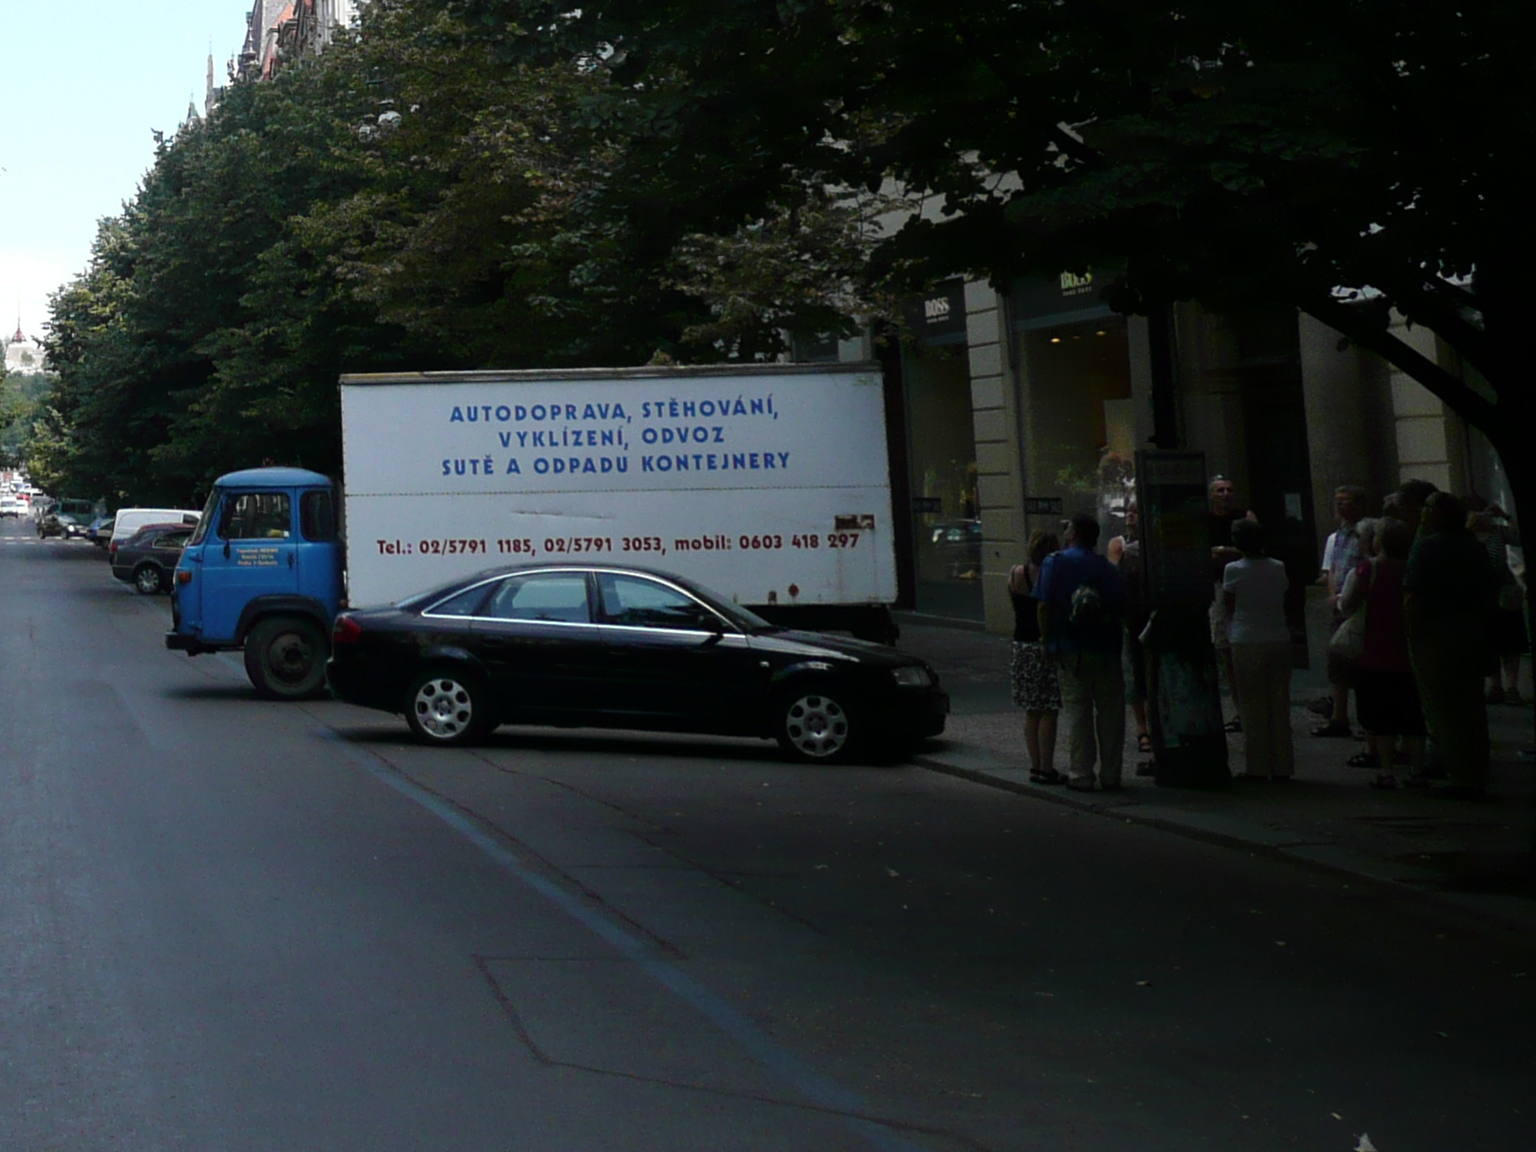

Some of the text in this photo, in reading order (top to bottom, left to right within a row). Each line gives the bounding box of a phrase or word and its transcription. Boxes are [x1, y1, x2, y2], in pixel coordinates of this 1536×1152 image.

[449, 395, 778, 424] AUTODOPRAVA, STĚHOVÁNÍ,
[498, 426, 725, 451] VYKLÍZENÍ, ODVOZ
[442, 452, 790, 476] SUTĚ A ODPADU KONTEJNERY
[376, 532, 860, 557] Tel.: 02/5791 1185, 02/5791 3053, mobil: 0603 418 297
